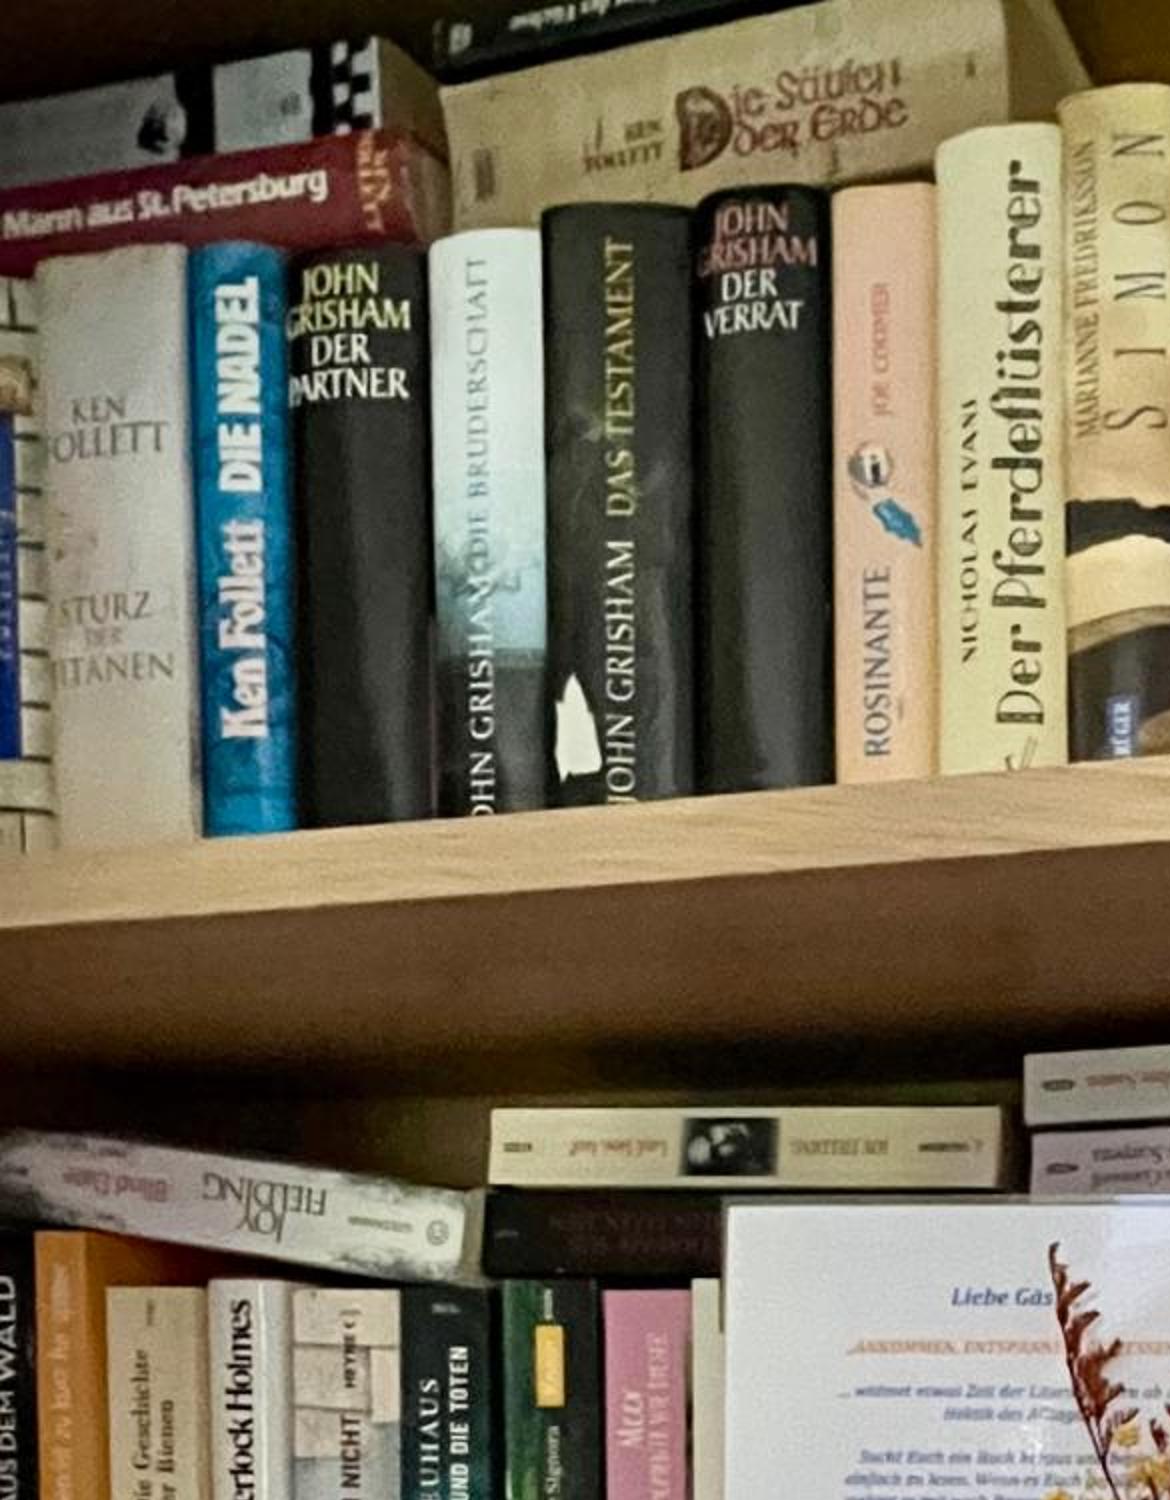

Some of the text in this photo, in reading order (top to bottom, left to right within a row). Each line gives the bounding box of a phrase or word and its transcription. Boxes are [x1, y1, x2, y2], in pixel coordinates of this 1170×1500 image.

[171, 167, 329, 213] Petersburg
[713, 200, 791, 238] JOHN
[302, 261, 380, 297] JOHN
[721, 269, 778, 303] DER
[311, 334, 371, 368] DER
[602, 234, 637, 440] TESTAMENT
[702, 298, 806, 341] VERRAT
[71, 395, 127, 426] KEN
[287, 366, 411, 408] PARTNER
[1070, 314, 1101, 441] MARIANNE
[988, 158, 1048, 727] Der Pferdeflüsterer
[214, 274, 269, 741] Ken Follett DIE NADEL
[604, 446, 637, 519] DAS
[462, 256, 497, 816] OHN DIE BRUDERSCHAFT
[604, 538, 637, 705] GRISHAM
[862, 566, 892, 760] ROSINANTE
[202, 1170, 328, 1218] FIELDING
[950, 1286, 1055, 1307] Liebe Gäs
[225, 1297, 255, 1411] Holmes
[447, 1345, 470, 1418] TOTEN
[130, 1348, 151, 1468] Geschichte
[154, 1398, 175, 1474] Bienen
[447, 1425, 470, 1456] DIE
[340, 1413, 362, 1490] NICHT
